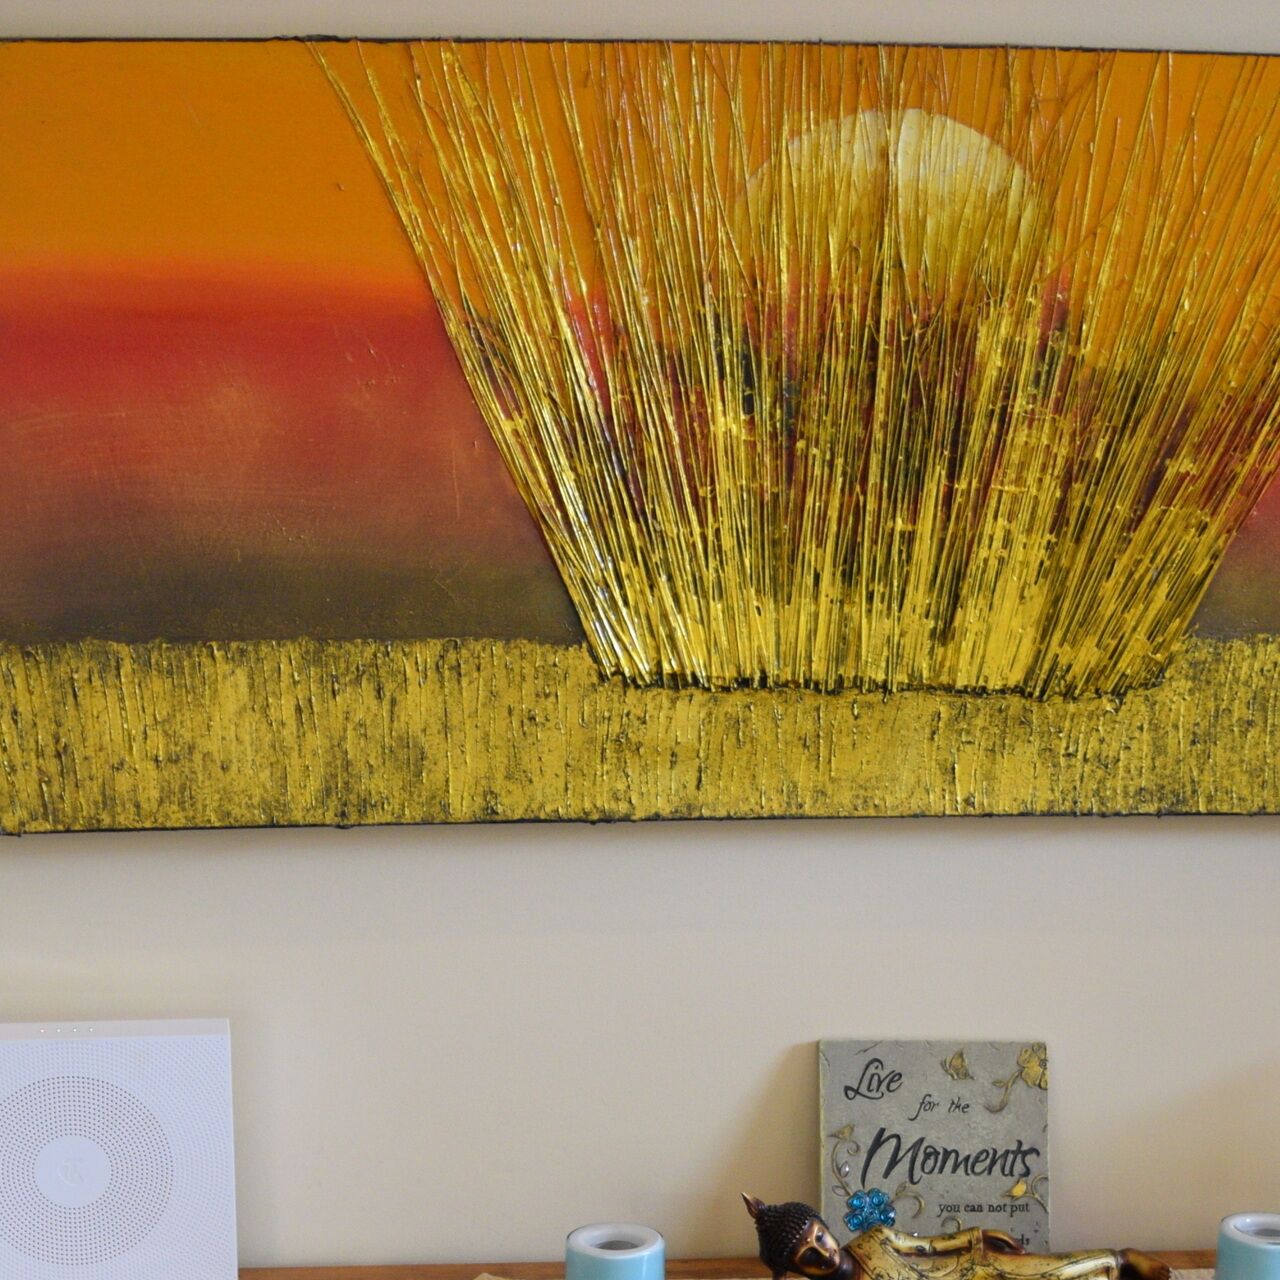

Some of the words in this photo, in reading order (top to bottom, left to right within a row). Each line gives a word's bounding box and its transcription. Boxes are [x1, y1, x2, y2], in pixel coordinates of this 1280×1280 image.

[844, 1058, 903, 1100] Live
[908, 1094, 939, 1121] for
[948, 1097, 970, 1113] the
[860, 1127, 1040, 1188] Moments
[938, 1204, 960, 1216] you
[964, 1203, 983, 1213] can
[988, 1203, 1008, 1214] not
[1010, 1203, 1030, 1216] put
